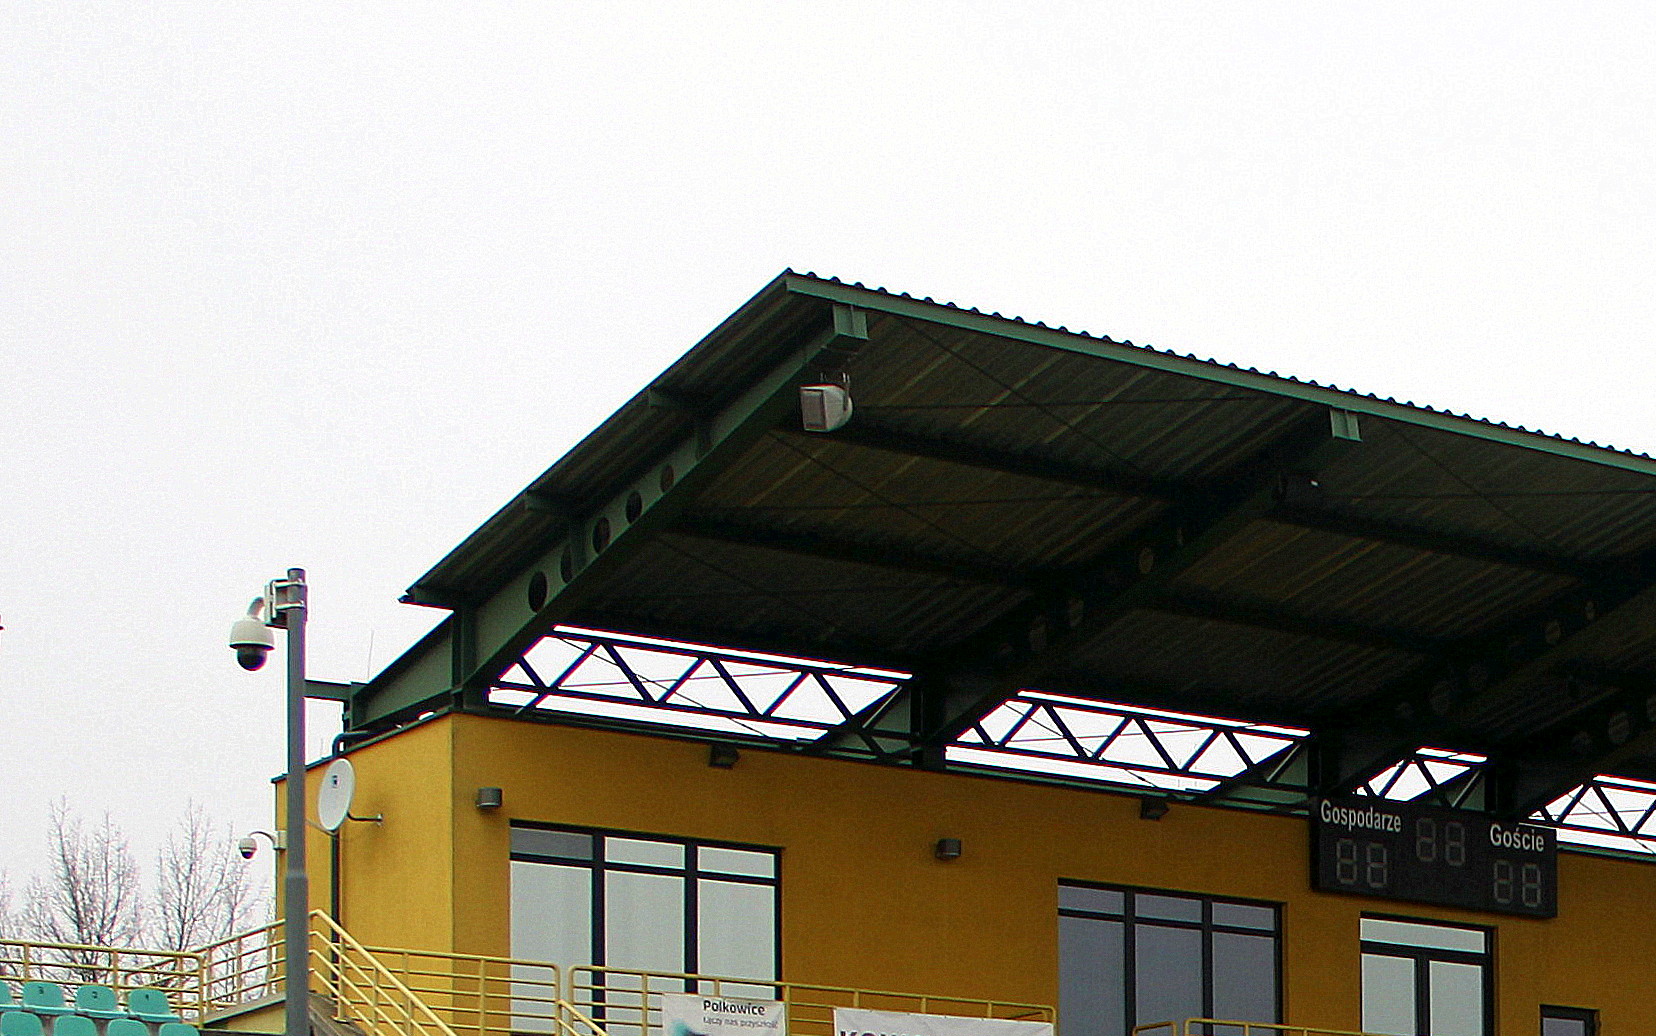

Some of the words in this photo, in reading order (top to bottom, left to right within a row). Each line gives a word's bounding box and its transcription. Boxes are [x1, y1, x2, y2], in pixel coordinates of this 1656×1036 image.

[1320, 800, 1401, 832] Gospodarze
[1490, 824, 1544, 852] Goście
[704, 1000, 765, 1015] Polkowice
